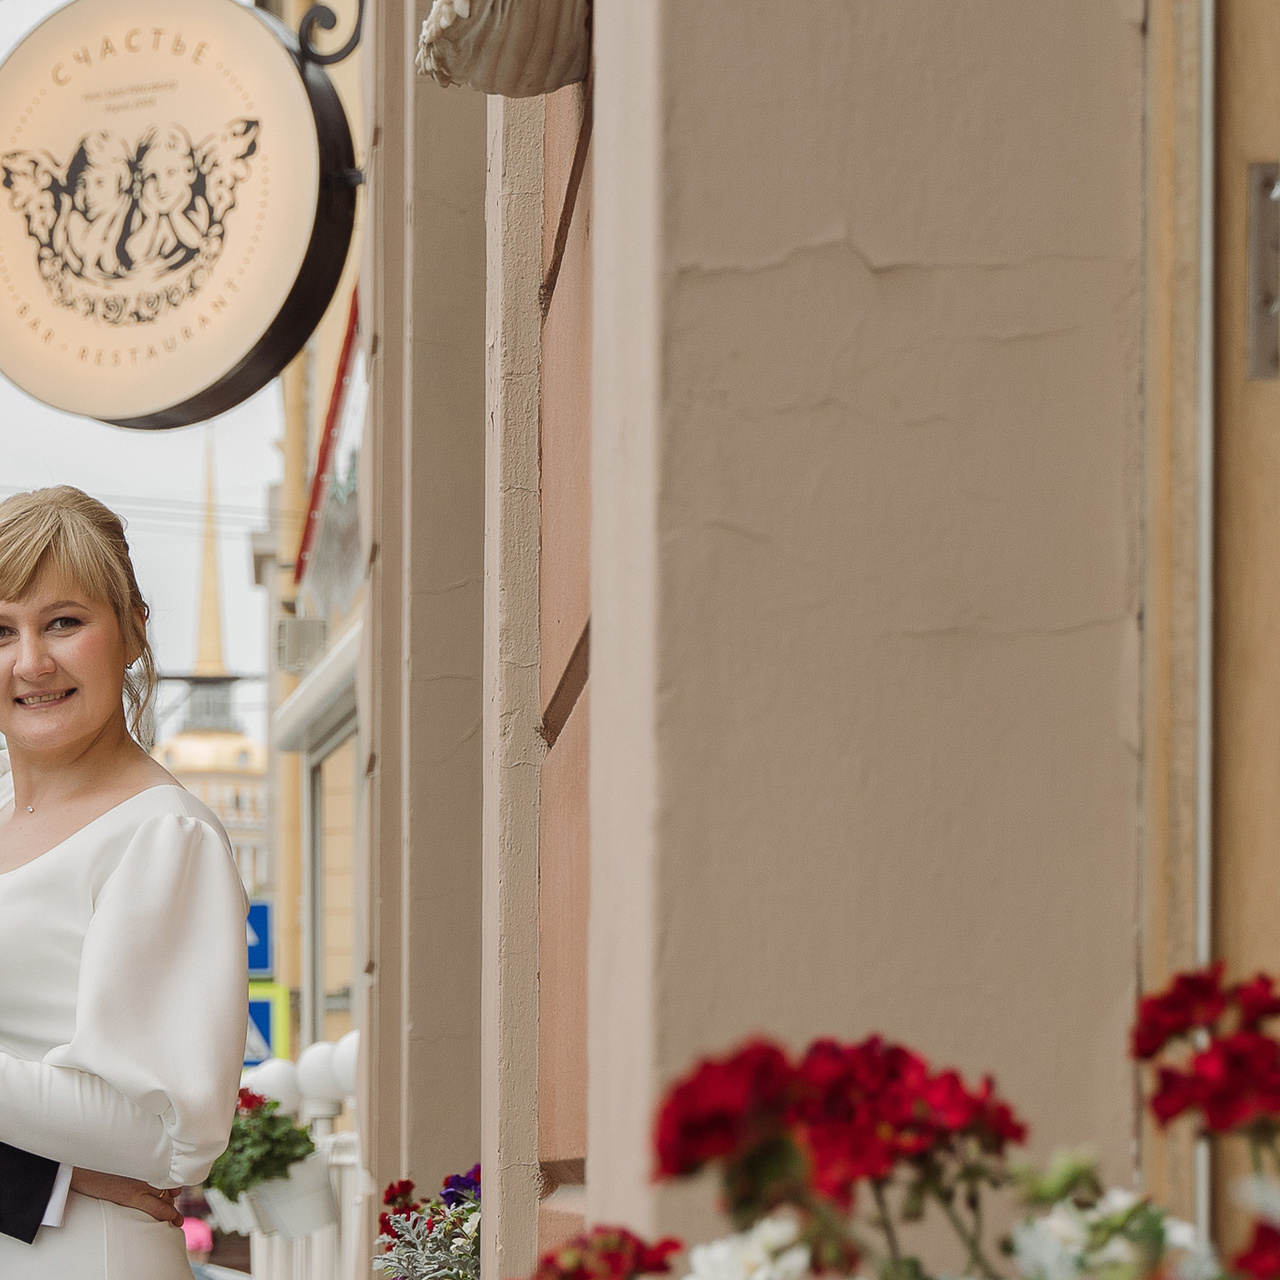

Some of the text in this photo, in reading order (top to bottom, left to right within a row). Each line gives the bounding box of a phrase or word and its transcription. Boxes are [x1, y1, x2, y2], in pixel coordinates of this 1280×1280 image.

[51, 28, 210, 87] СЧАСТЬЕ
[15, 279, 241, 366] BAR RESTAURANT
